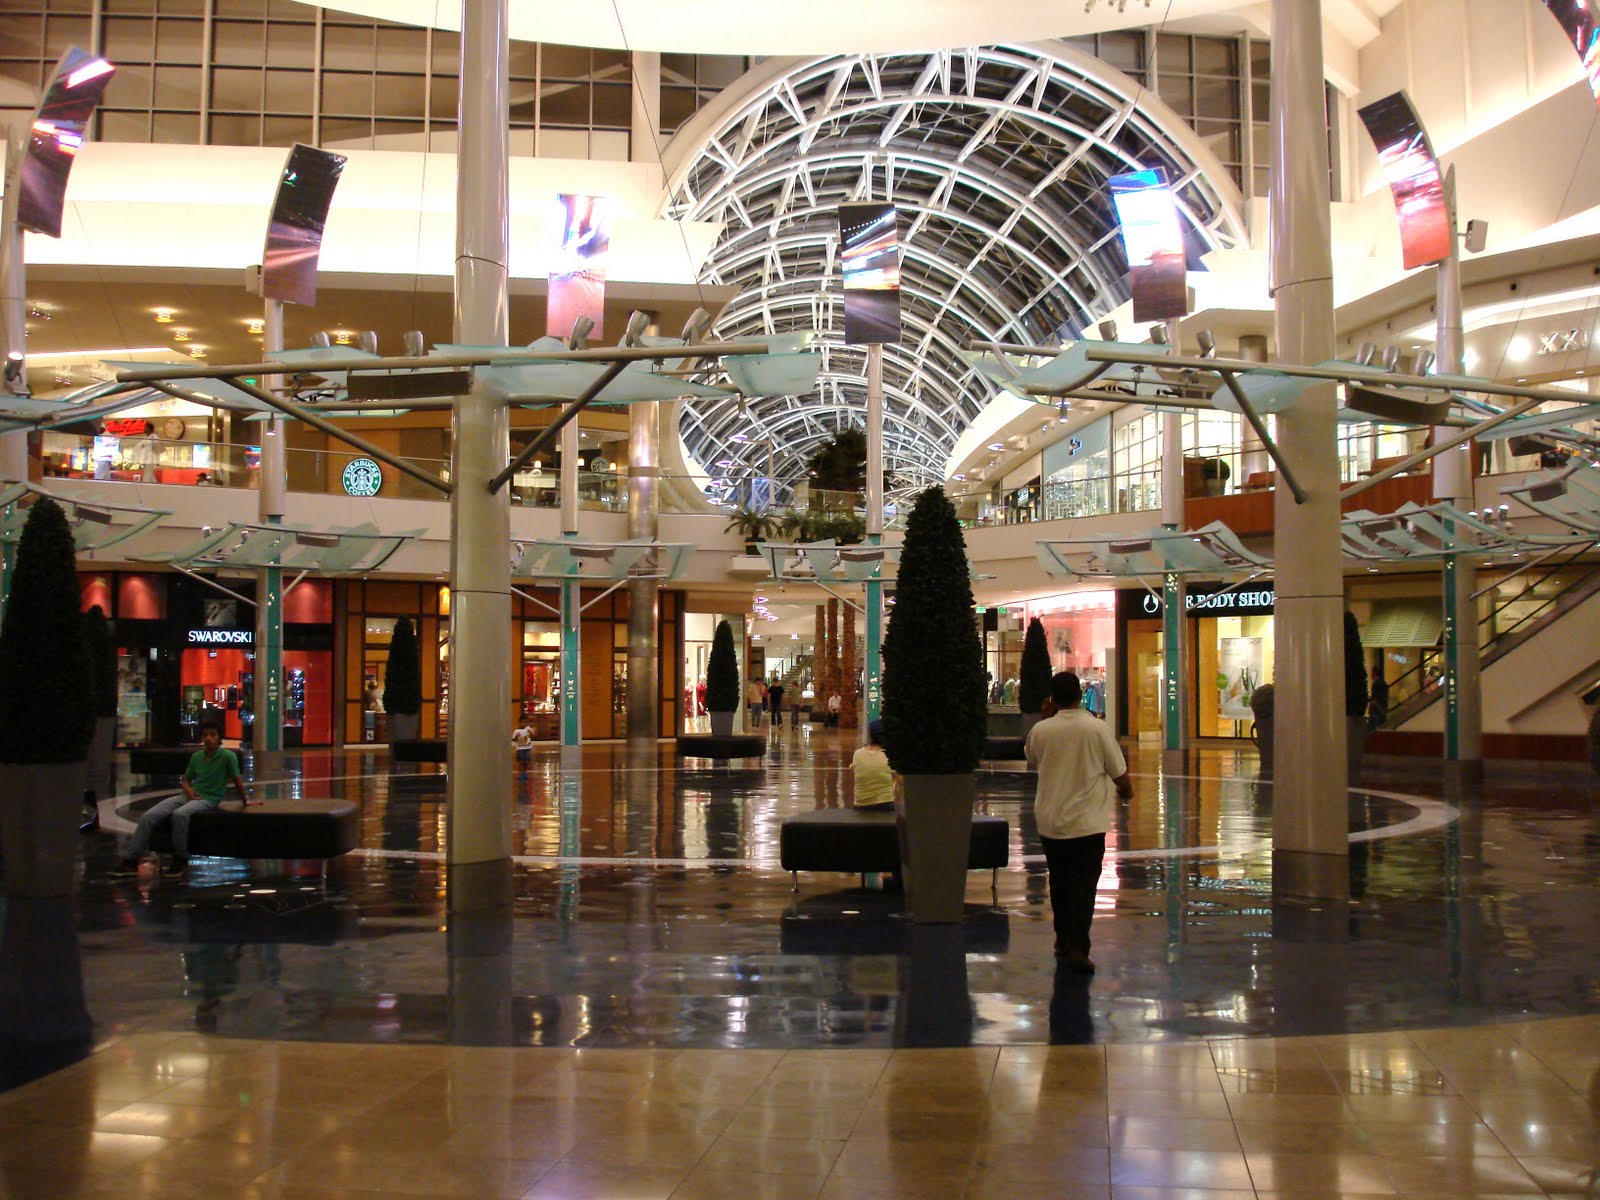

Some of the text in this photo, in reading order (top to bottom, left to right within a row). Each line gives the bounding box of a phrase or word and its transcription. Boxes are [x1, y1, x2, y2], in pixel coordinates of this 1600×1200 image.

[344, 460, 380, 478] STARBUCKS
[1196, 593, 1237, 609] BODY
[188, 630, 252, 643] SWAROVSKI
